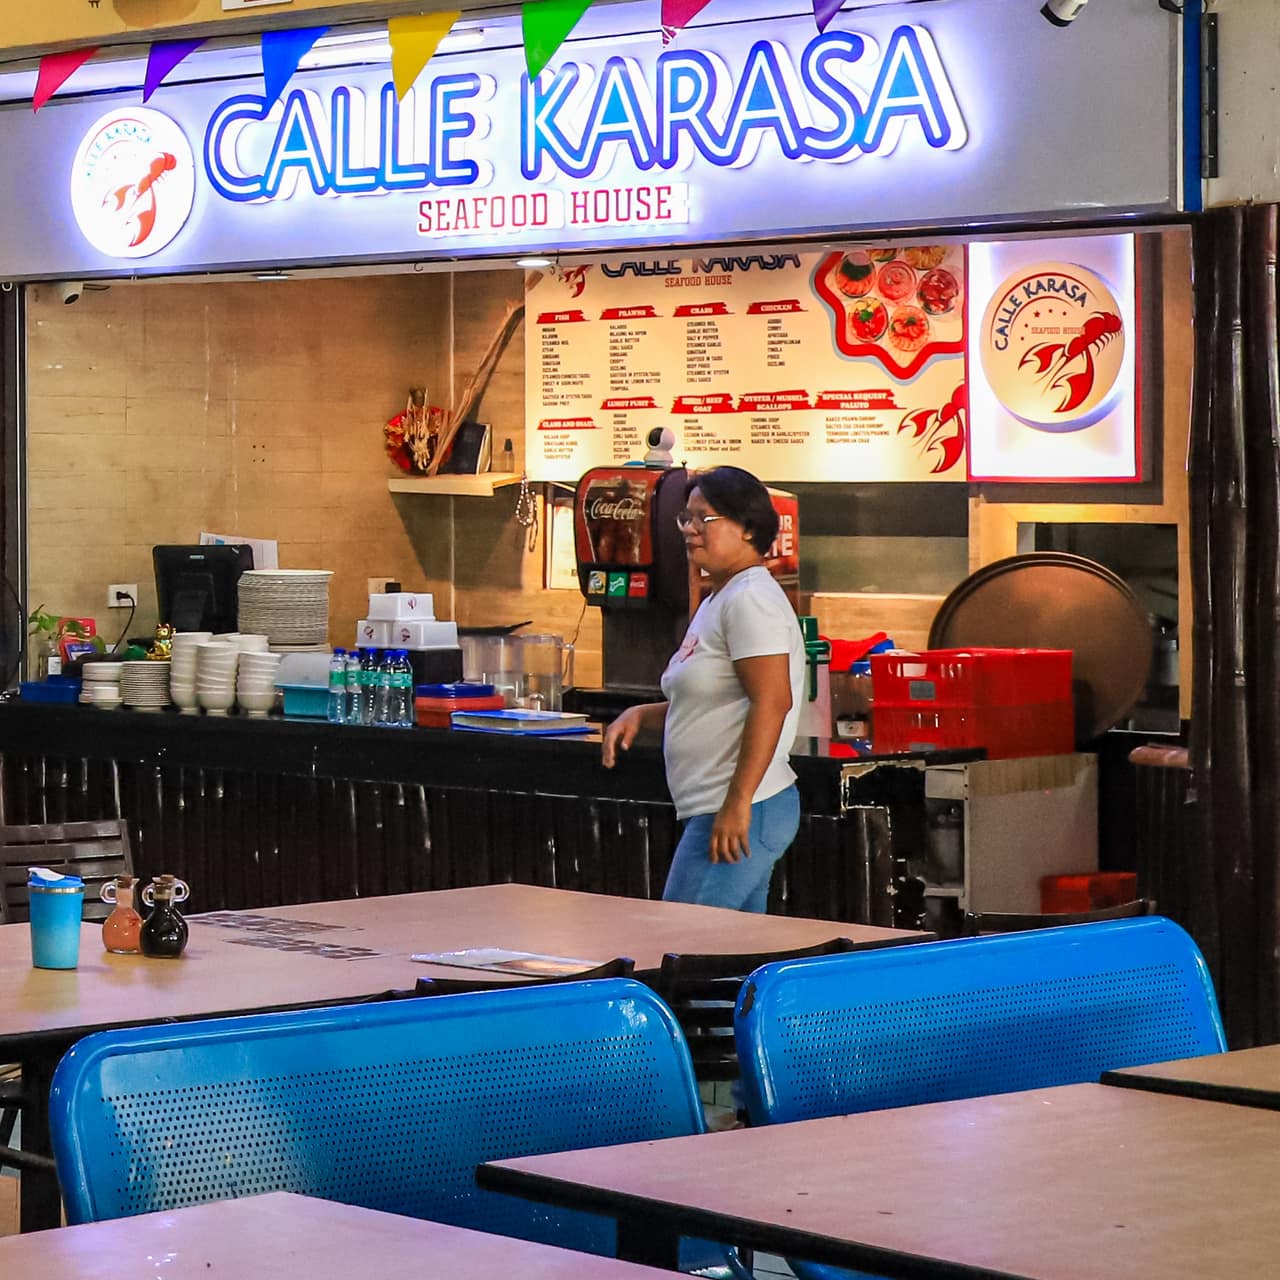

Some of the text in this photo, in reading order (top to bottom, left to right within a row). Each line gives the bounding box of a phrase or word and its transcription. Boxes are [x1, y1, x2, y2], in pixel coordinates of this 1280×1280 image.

[520, 24, 955, 180] KARASA
[204, 72, 485, 203] CALLE
[418, 187, 672, 233] SEAFOOD HOUSE
[664, 274, 732, 288] SEAFOOD HOUSE
[994, 278, 1089, 351] CALLE KARASA
[590, 497, 646, 520] Coca-Cola
